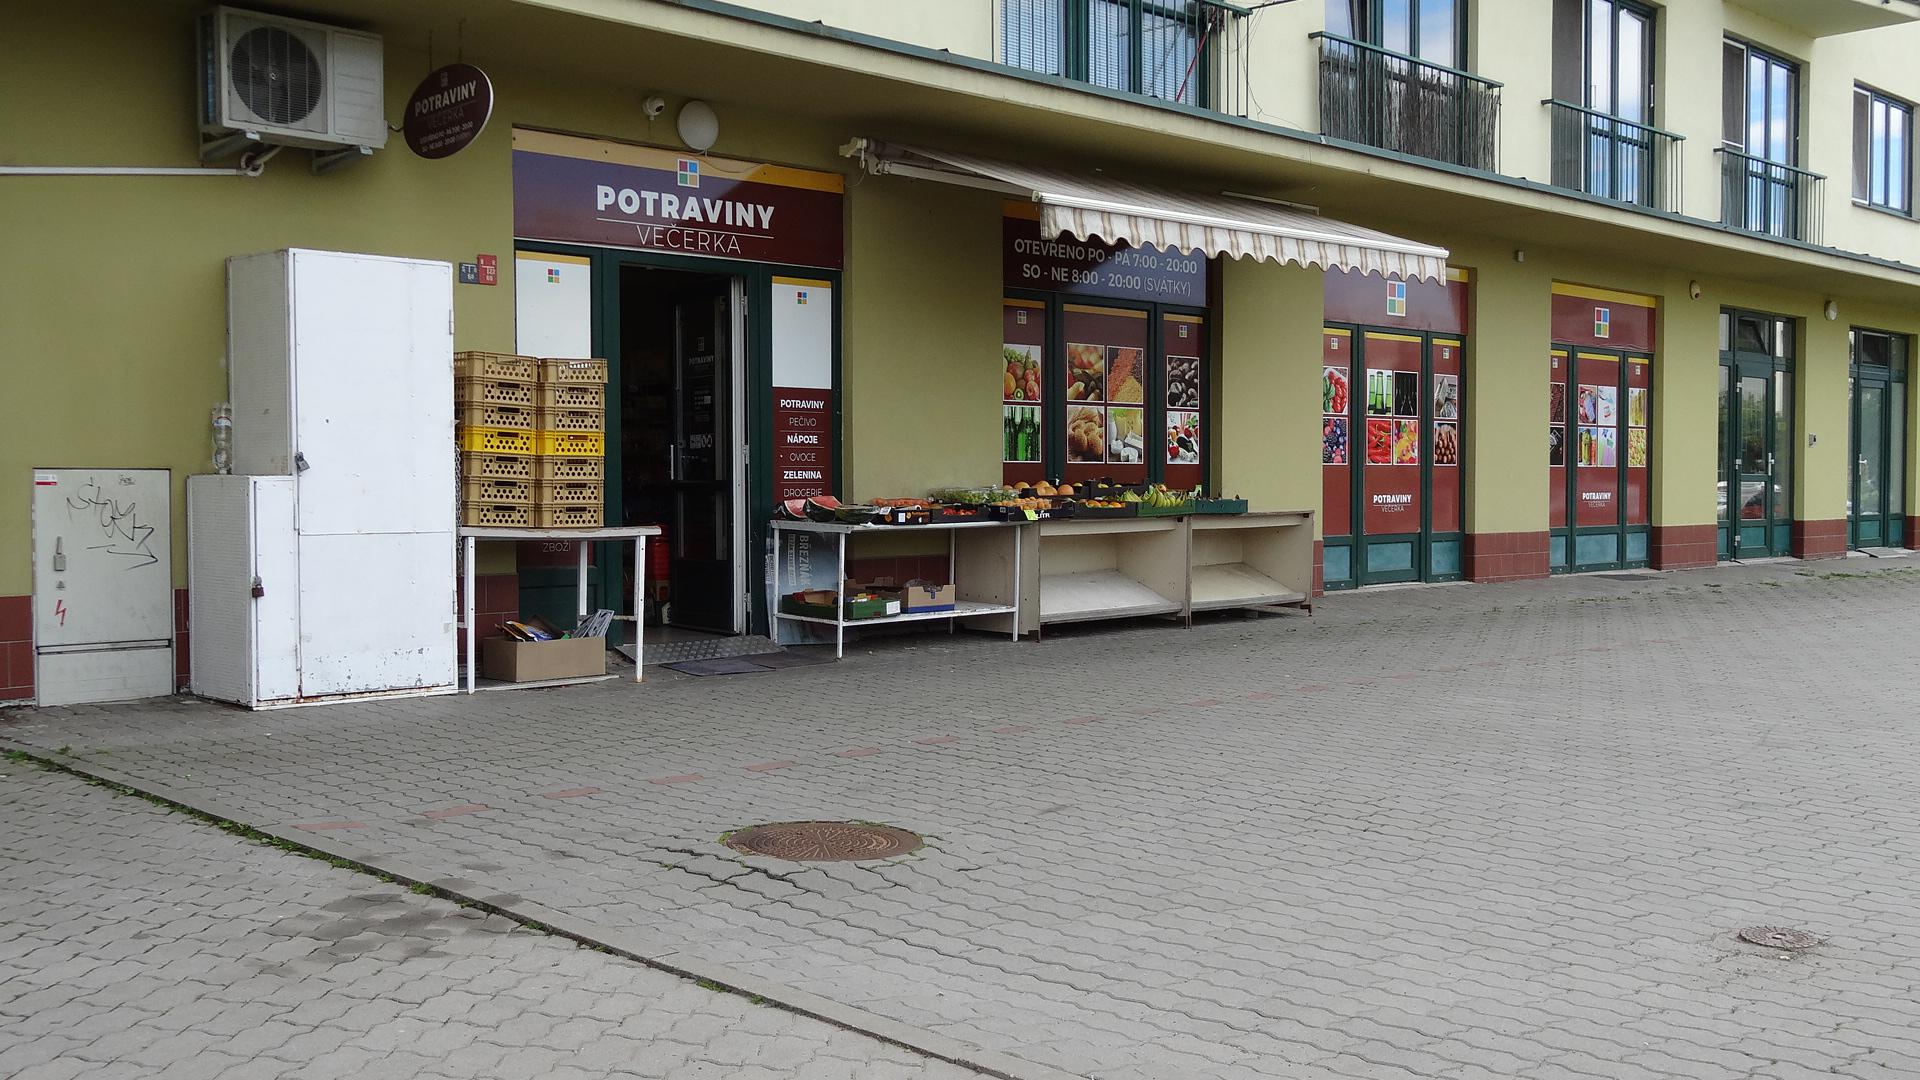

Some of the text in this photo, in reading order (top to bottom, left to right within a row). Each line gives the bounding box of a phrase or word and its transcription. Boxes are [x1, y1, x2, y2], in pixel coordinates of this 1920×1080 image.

[414, 80, 477, 117] POTRAVINY
[596, 184, 775, 230] POTRAVINY
[636, 223, 742, 255] VEČERKA
[1014, 238, 1085, 260] OTEVŘENO
[1088, 252, 1105, 263] PO
[1114, 248, 1130, 267] PÁ
[1132, 253, 1157, 269] 7:00
[1166, 258, 1197, 274] 20:00
[1022, 264, 1040, 279] SO
[1051, 267, 1069, 283] NE
[1071, 270, 1098, 285] 8:00
[1108, 273, 1141, 290] 20:00
[1143, 276, 1191, 297] (SVÁTKY)
[780, 399, 824, 409] POTRAVINY
[789, 416, 817, 427] PEČIVO
[787, 432, 818, 444] NÁPOJE
[789, 452, 816, 462] OVOCE
[783, 470, 822, 479] ZELENINA
[783, 488, 823, 498] DROGERIE
[1373, 494, 1412, 503] POTRAVINY
